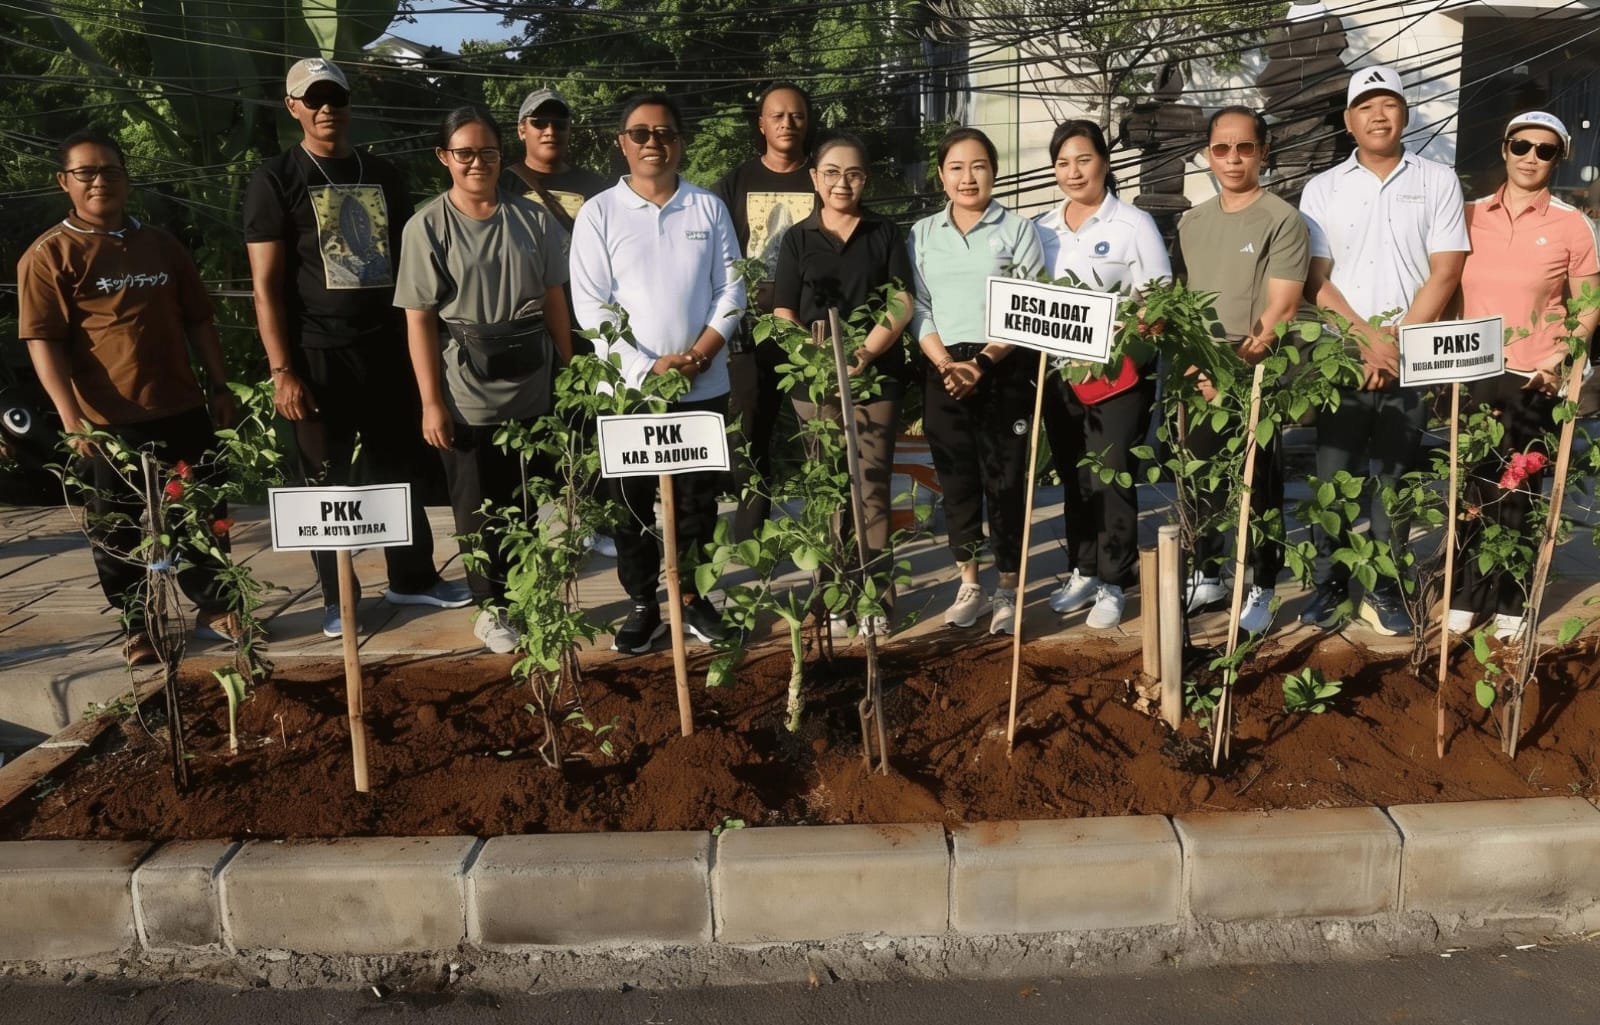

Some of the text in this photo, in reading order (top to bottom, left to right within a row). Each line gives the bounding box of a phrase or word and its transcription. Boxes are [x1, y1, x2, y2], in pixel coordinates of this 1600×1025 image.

[1011, 294, 1090, 323] DESA ADAT
[1004, 313, 1093, 344] KEROBOKAN
[643, 424, 683, 446] PKK
[622, 450, 649, 465] KAB
[320, 500, 363, 522] PKK
